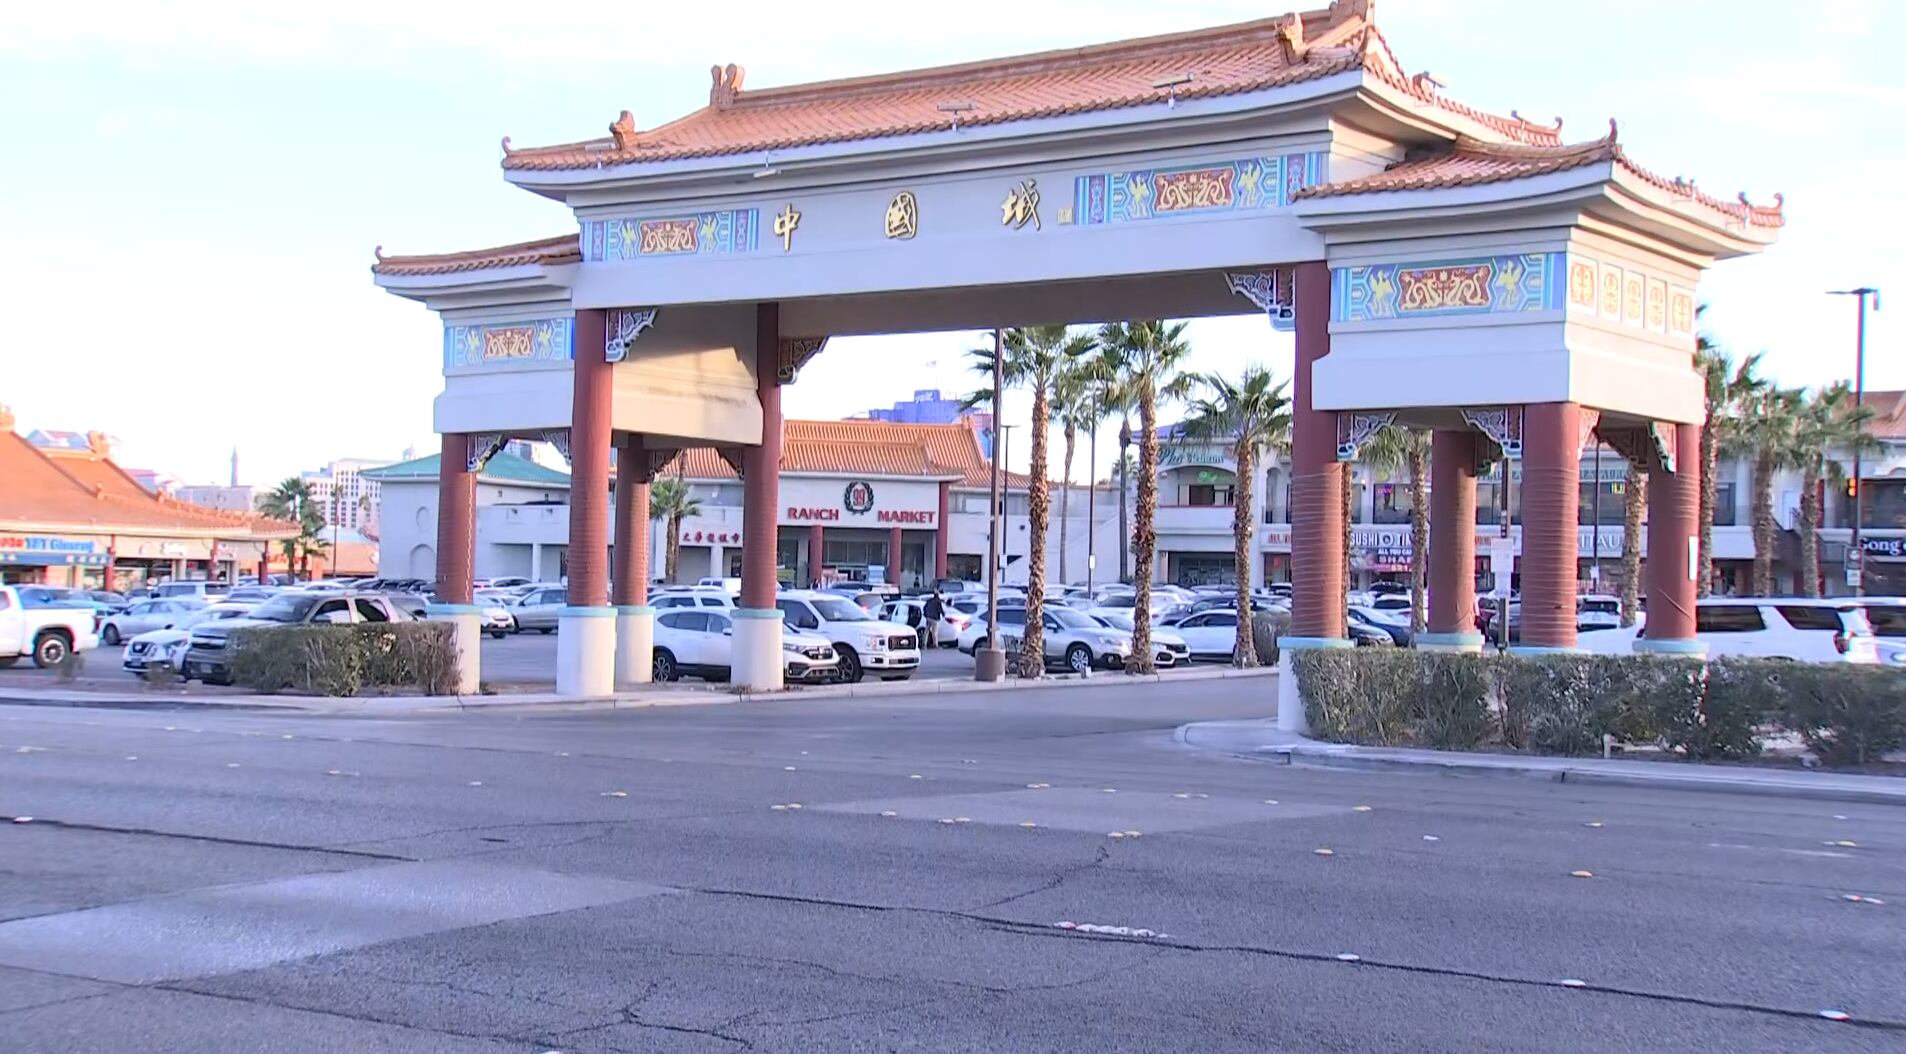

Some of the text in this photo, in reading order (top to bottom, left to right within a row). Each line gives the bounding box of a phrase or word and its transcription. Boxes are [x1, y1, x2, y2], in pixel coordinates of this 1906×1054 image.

[853, 488, 866, 507] 99
[787, 507, 936, 524] RANCH MARKET
[1350, 532, 1379, 546] SUSHI
